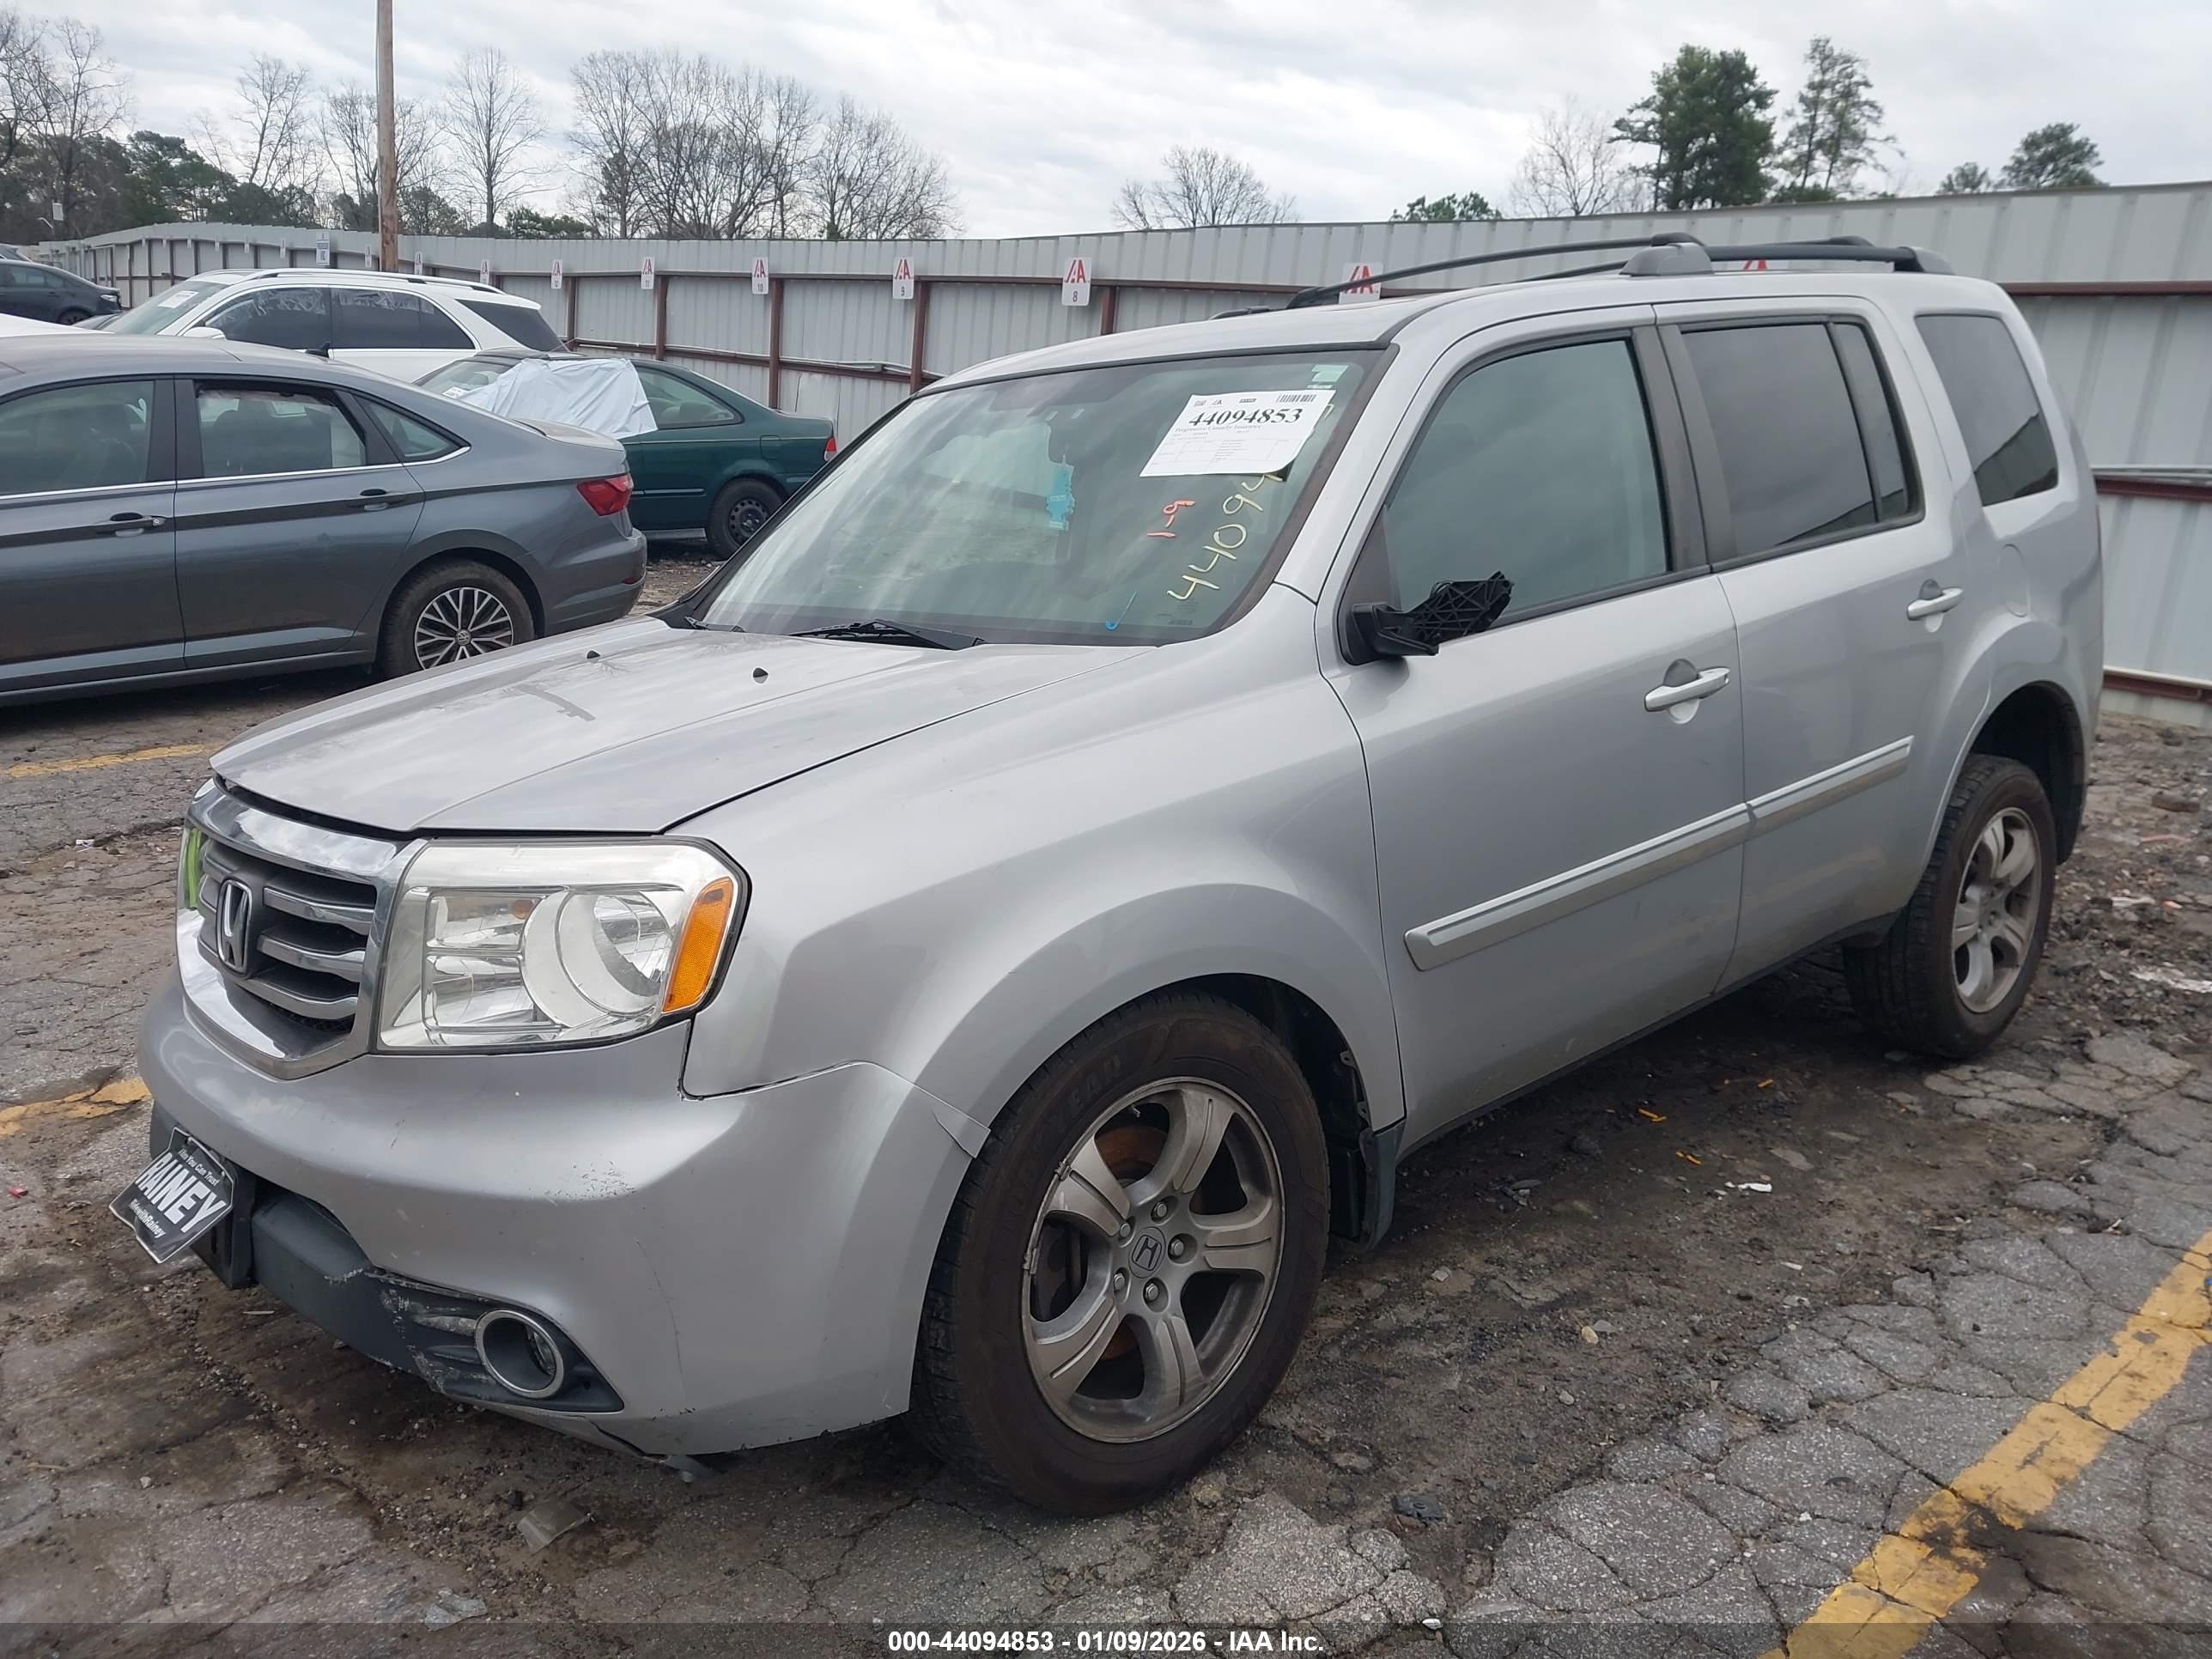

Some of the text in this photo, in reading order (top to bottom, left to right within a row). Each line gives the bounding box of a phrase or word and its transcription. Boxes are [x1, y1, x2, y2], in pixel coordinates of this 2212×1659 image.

[901, 286, 905, 296] 9
[1073, 290, 1078, 302] 8
[1188, 408, 1304, 427] 44094853
[186, 1155, 220, 1186] You Can Trust
[135, 1152, 226, 1233] RAINEY
